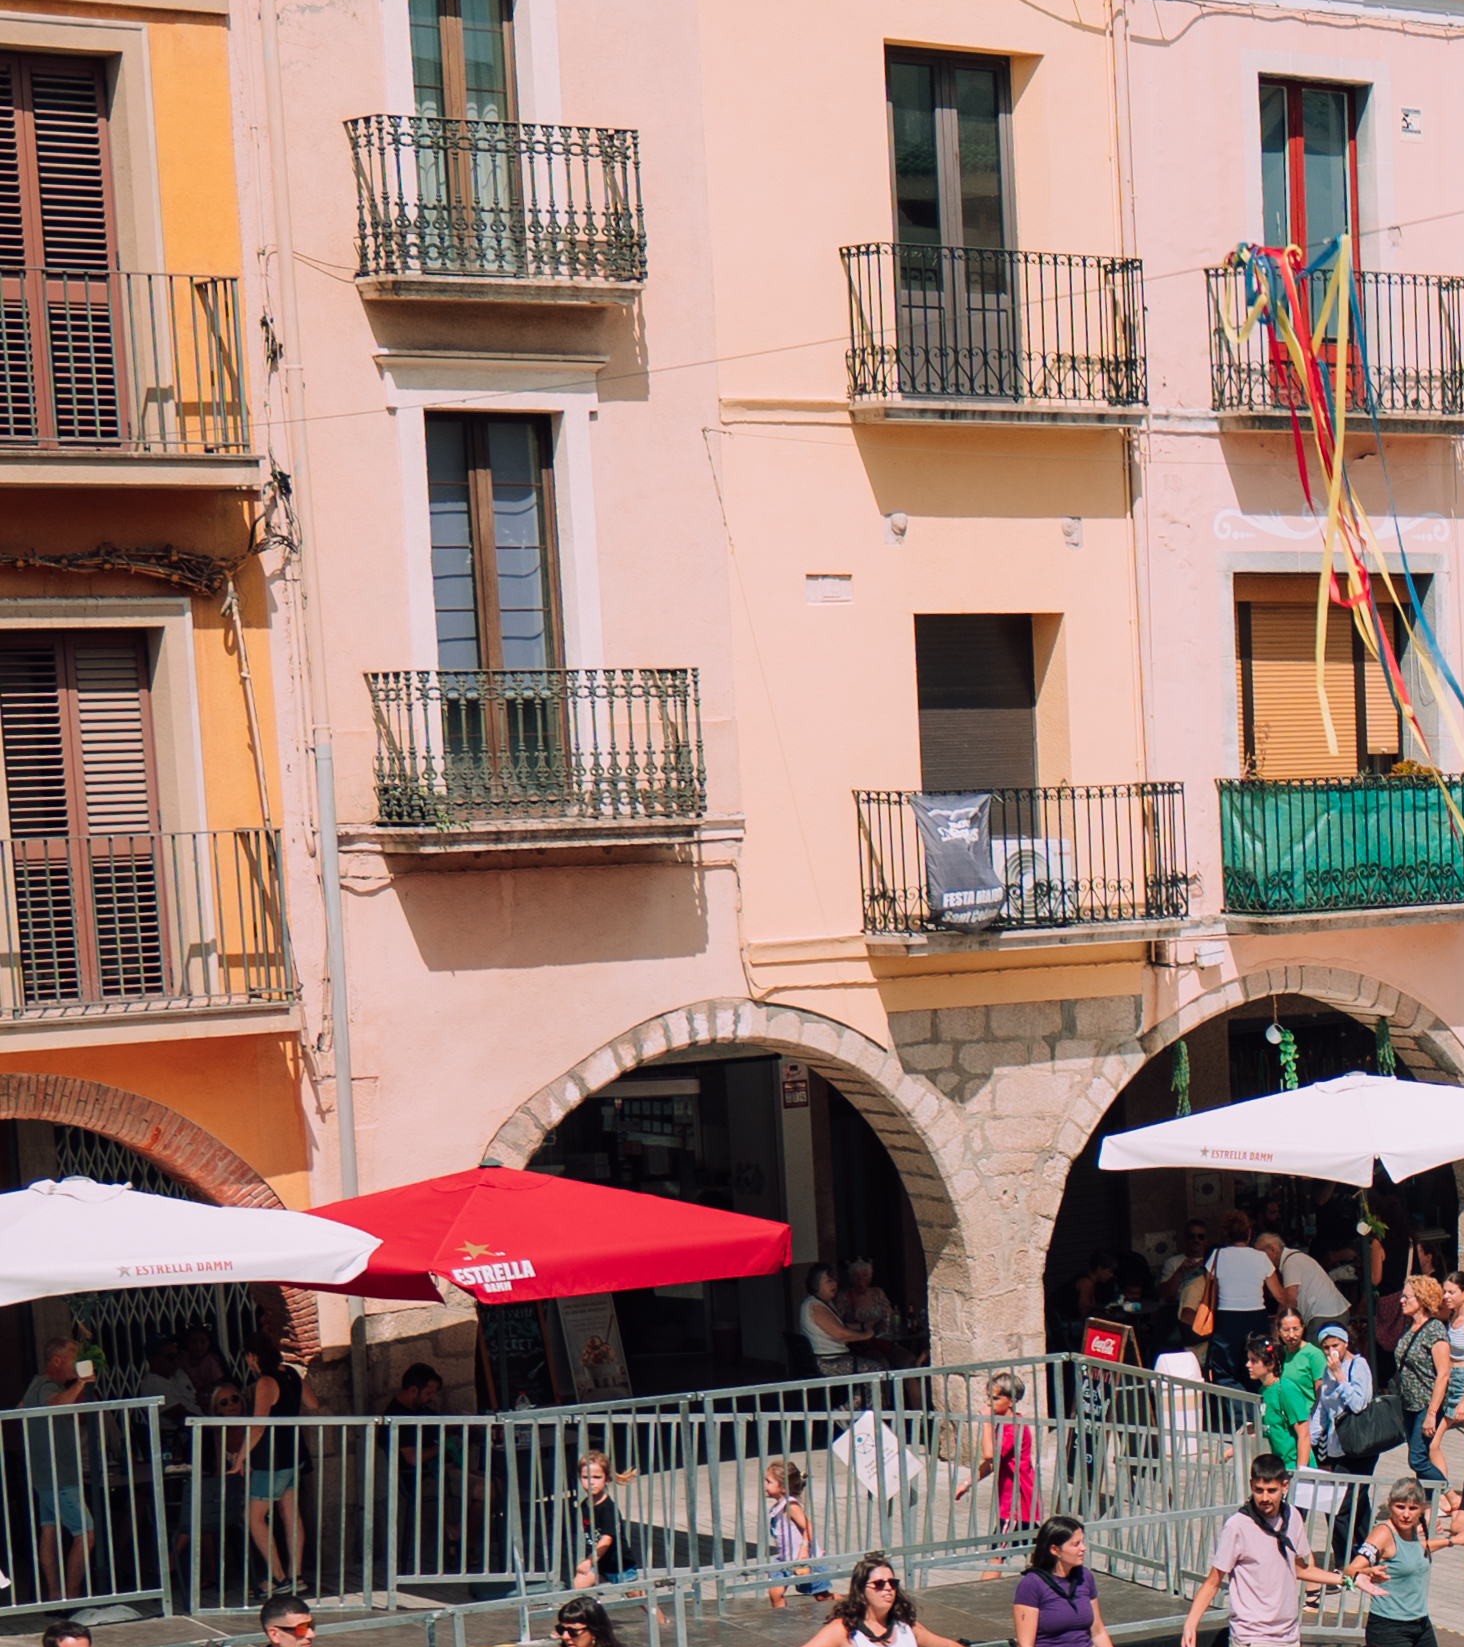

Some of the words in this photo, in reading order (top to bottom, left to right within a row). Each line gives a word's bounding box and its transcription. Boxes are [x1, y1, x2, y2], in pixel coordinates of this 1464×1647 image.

[1210, 1149, 1247, 1160] ESTRELLA
[1248, 1151, 1274, 1163] DAMM
[135, 1262, 193, 1276] ESTRELLA
[196, 1260, 233, 1272] DAMM
[451, 1259, 537, 1286] ESTRELLA
[483, 1280, 513, 1294] DAMM
[489, 1338, 534, 1352] SCRET
